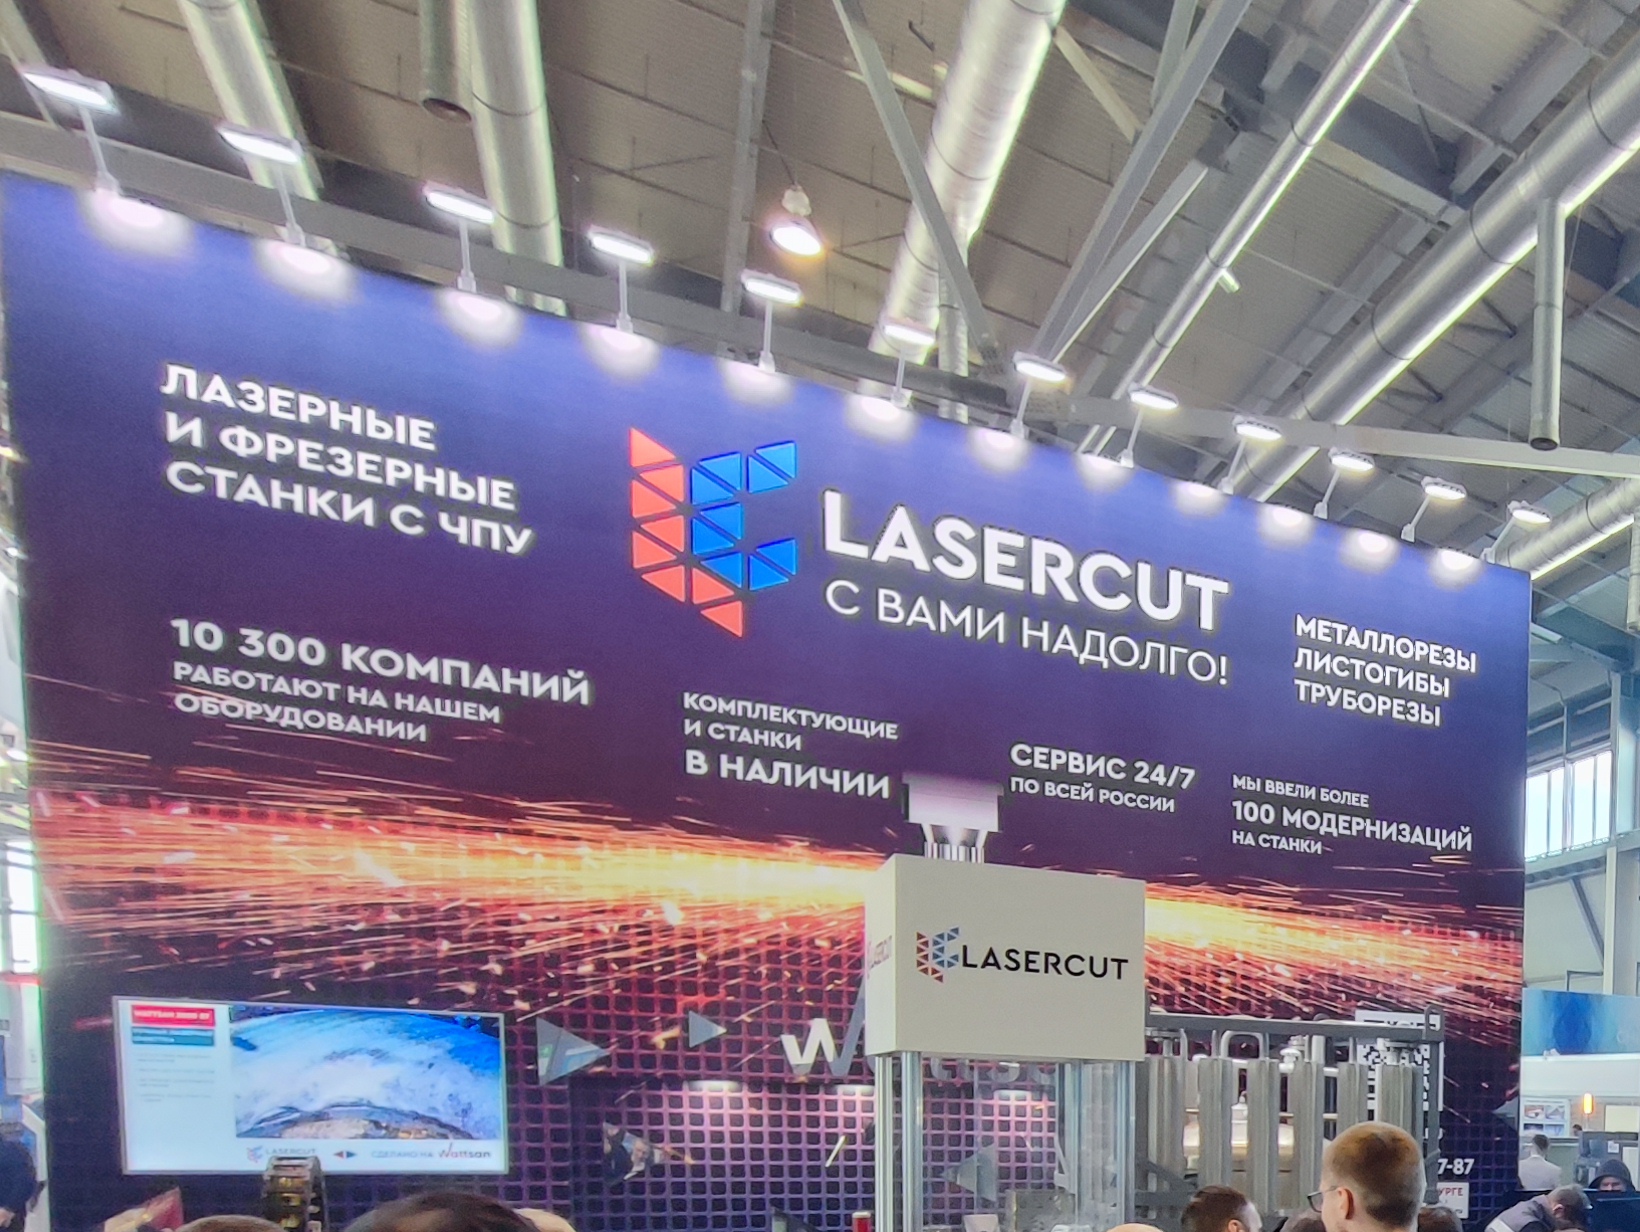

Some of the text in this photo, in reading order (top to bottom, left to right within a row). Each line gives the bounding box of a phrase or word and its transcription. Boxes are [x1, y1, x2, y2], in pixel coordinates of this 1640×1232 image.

[161, 364, 436, 451] ЛАЗЕРНЫЕ
[166, 411, 515, 511] И ФРЕЗЕРНЫЕ
[166, 461, 533, 554] СТАНКИ С ЧПУ
[824, 490, 1230, 631] LASERCUT
[826, 579, 1227, 686] С ВАМИ НАДОЛГО!
[1296, 614, 1477, 673] МЕТАЛЛОРЕЗЫ
[170, 618, 590, 706] 10 300 КОМПАНИЙ
[1294, 647, 1450, 698] ЛИСТОГИБЫ
[174, 661, 501, 724] РАБОТАЮТ НА НАШЕМ
[174, 693, 427, 742] ОБОРУДОВАНИИ
[683, 692, 898, 740] КОМПЛЕКТУЮЩИЕ
[1294, 679, 1441, 727] ТРУБОРЕЗЫ
[684, 718, 802, 751] И СТАНКИ
[685, 749, 889, 799] В НАЛИЧИИ
[1010, 743, 1196, 789] СЕРВИС 24/7
[1233, 774, 1369, 808] МЫ ВВЕЛИ БОЛЕЕ
[1010, 776, 1175, 813] ПО ВСЕЙ РОССИИ
[1232, 800, 1472, 852] 100 МОДЕРНИЗАЦИЙ
[1232, 830, 1322, 855] НА СТАНКИ
[961, 946, 1130, 981] LASERCUT
